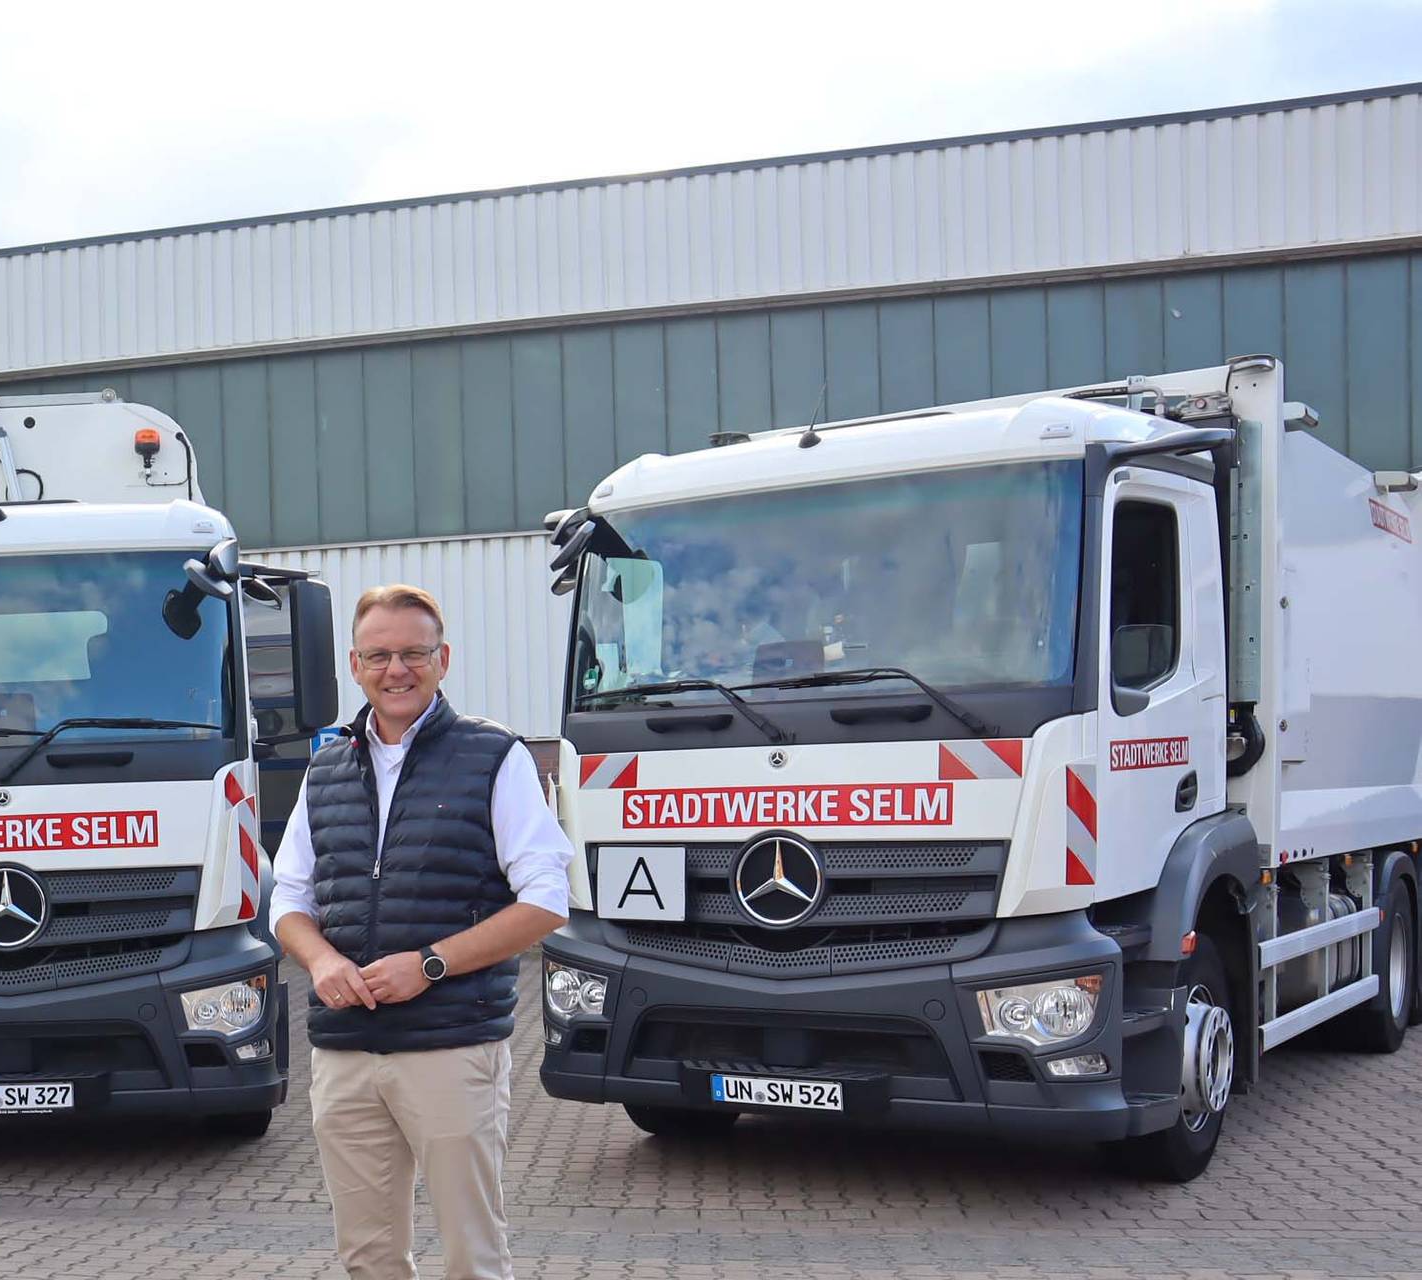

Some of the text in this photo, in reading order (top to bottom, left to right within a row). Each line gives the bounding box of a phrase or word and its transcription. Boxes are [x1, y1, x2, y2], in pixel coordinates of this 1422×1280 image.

[1111, 740, 1188, 768] STADTWERKE SELM
[626, 788, 948, 825] STADTWERKE SELM
[71, 816, 154, 846] SELM
[617, 856, 665, 910] A
[5, 1087, 29, 1106] SW
[35, 1086, 71, 1105] 327
[725, 1080, 753, 1101] UN
[767, 1082, 793, 1103] SW
[799, 1085, 840, 1107] 524
